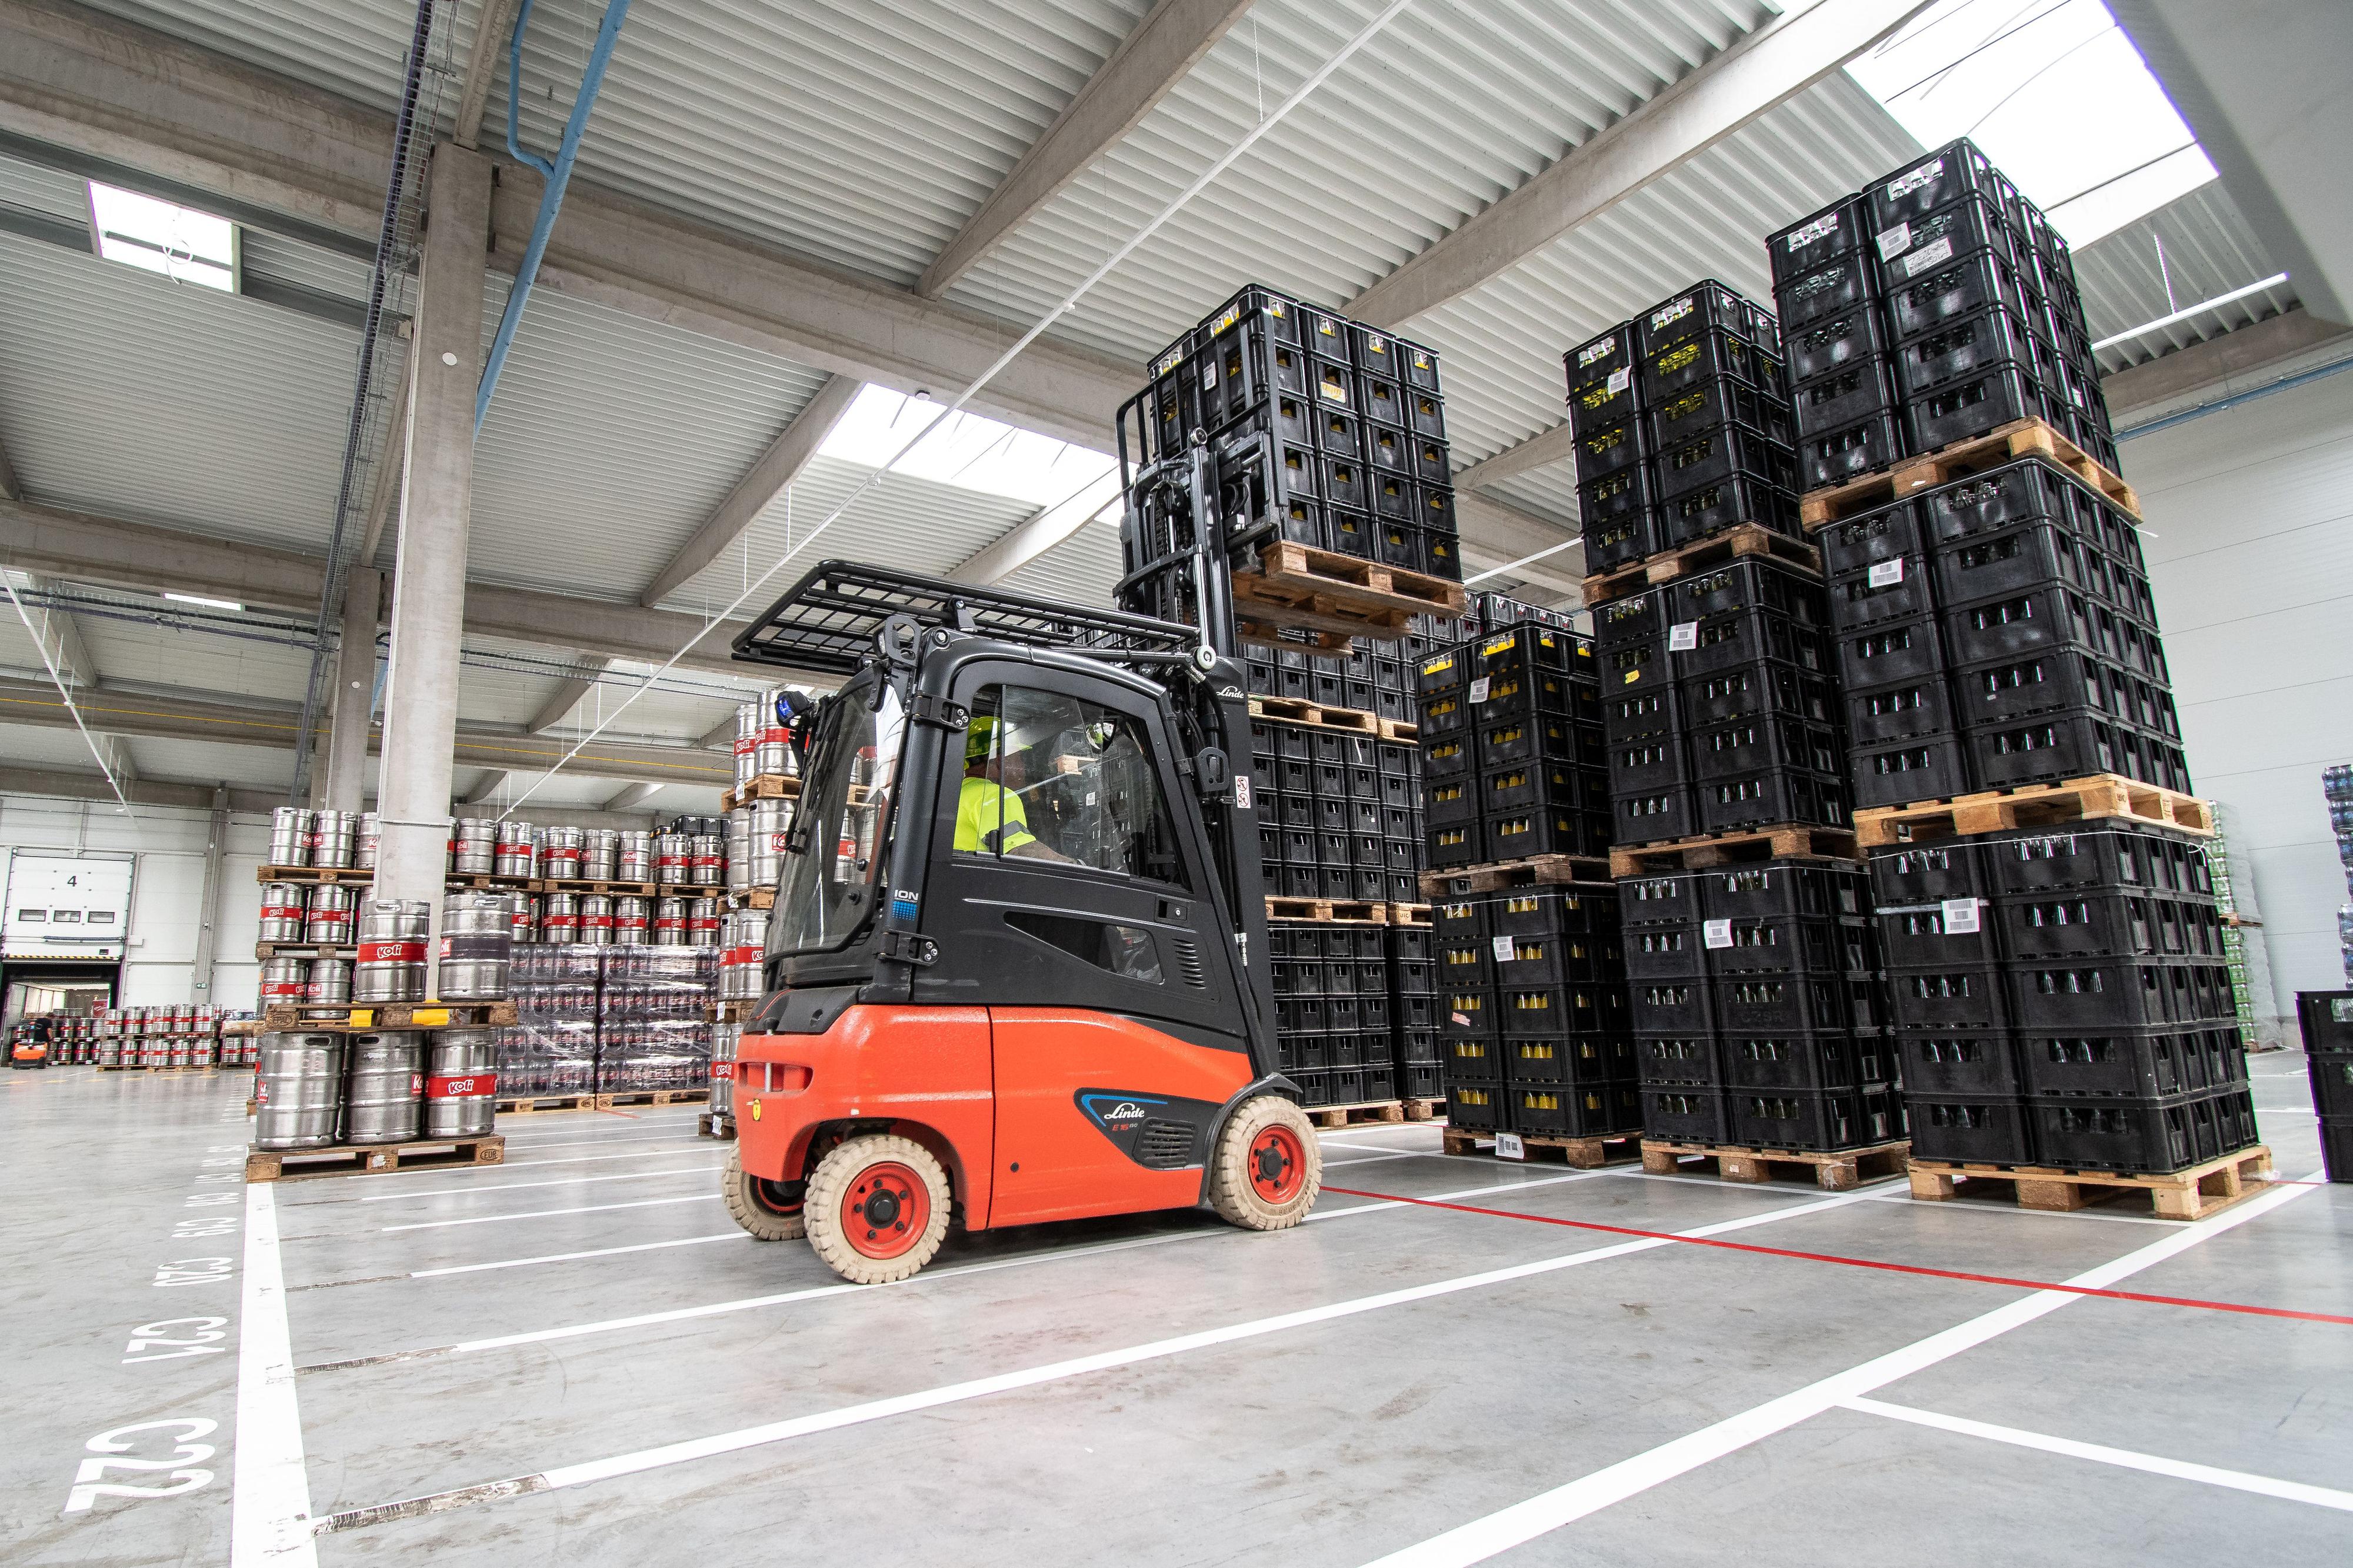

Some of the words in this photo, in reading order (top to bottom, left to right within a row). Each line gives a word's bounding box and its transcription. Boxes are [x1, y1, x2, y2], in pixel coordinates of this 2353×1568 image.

[1217, 686, 1244, 699] Linde
[755, 730, 766, 743] oli
[736, 739, 749, 752] Koli
[303, 835, 311, 843] Ko
[68, 875, 77, 887] 4
[894, 889, 919, 900] ION
[269, 908, 284, 916] Koli
[377, 944, 402, 959] Koli
[441, 939, 451, 953] oli
[752, 950, 764, 961] Ko
[265, 985, 278, 993] Koli
[308, 985, 321, 993] Koli
[448, 1079, 474, 1095] Koli
[1104, 1103, 1145, 1120] Linde
[484, 1150, 497, 1159] EUR
[195, 1173, 241, 1184] C17
[184, 1192, 240, 1207] C18
[171, 1217, 238, 1237] C19
[152, 1257, 233, 1287] C20
[122, 1316, 228, 1364] C21
[64, 1417, 218, 1513] C22
